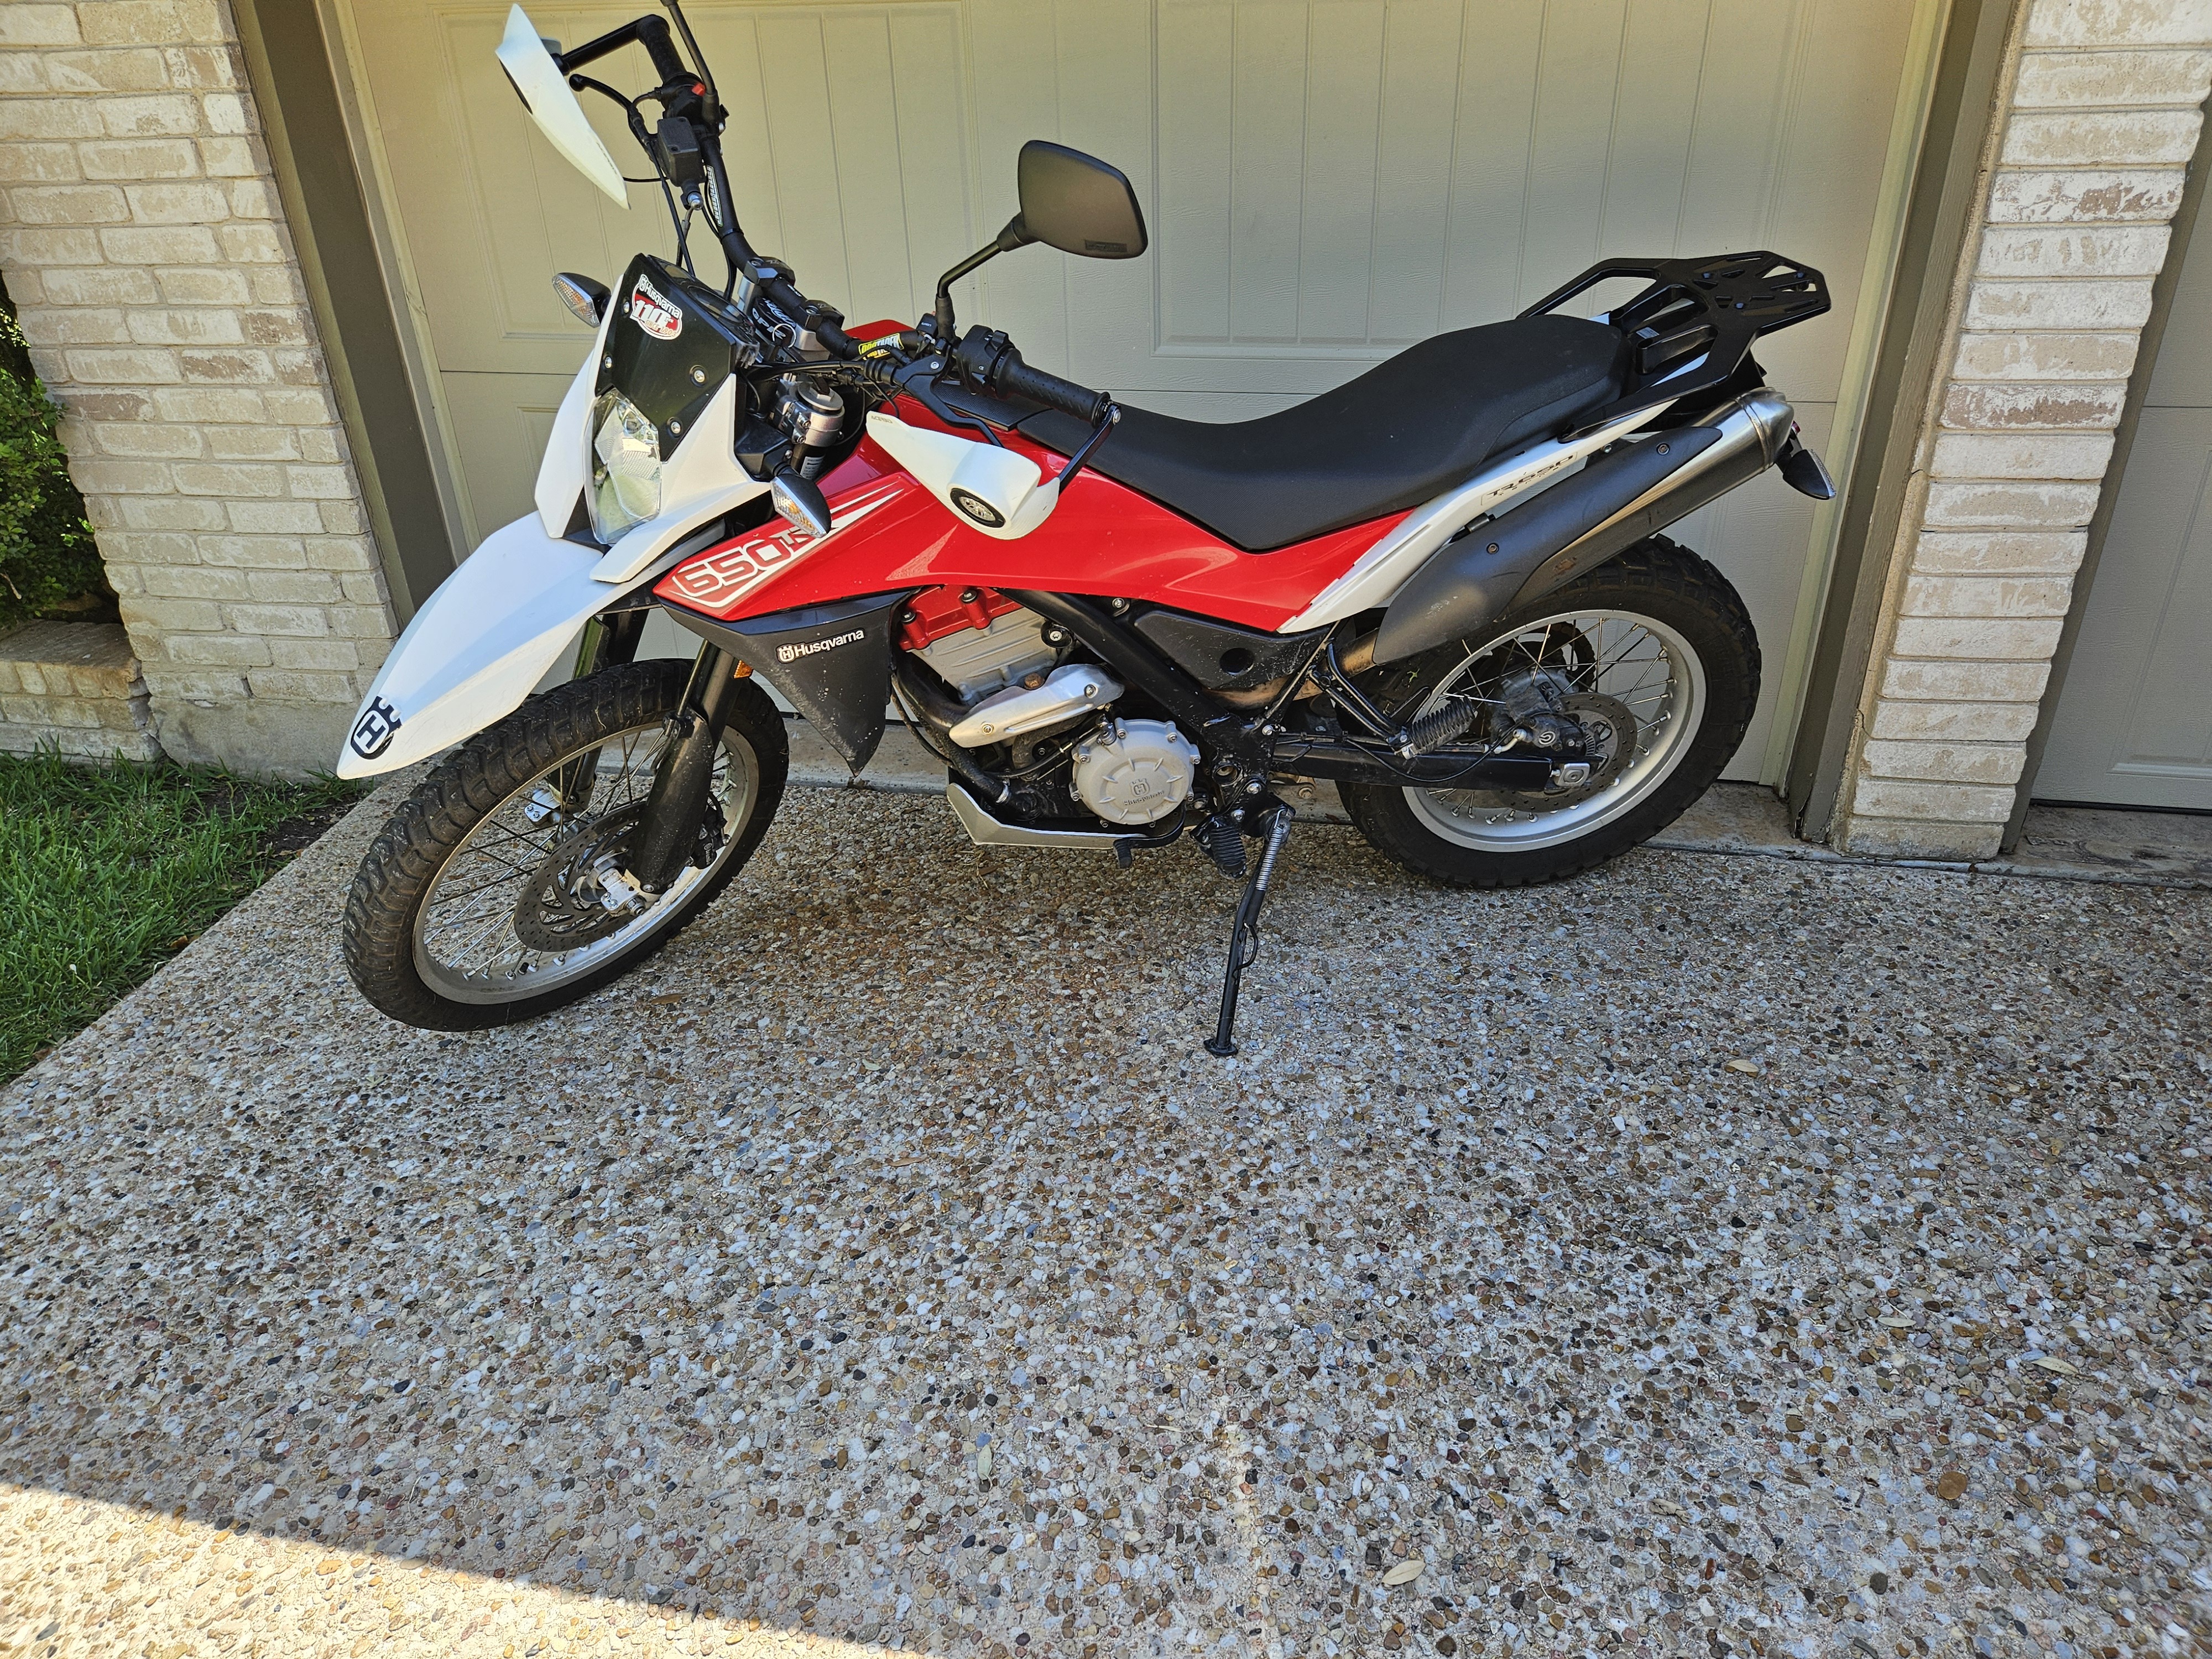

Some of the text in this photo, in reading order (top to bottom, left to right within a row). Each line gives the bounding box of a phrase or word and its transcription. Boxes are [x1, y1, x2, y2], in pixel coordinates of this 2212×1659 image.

[632, 300, 671, 328] 110
[644, 282, 680, 319] Husqvarna
[644, 320, 660, 330] SINCE
[661, 327, 677, 337] 1903
[753, 308, 786, 340] GPR
[672, 539, 792, 597] 650
[794, 630, 864, 657] Husqvarna
